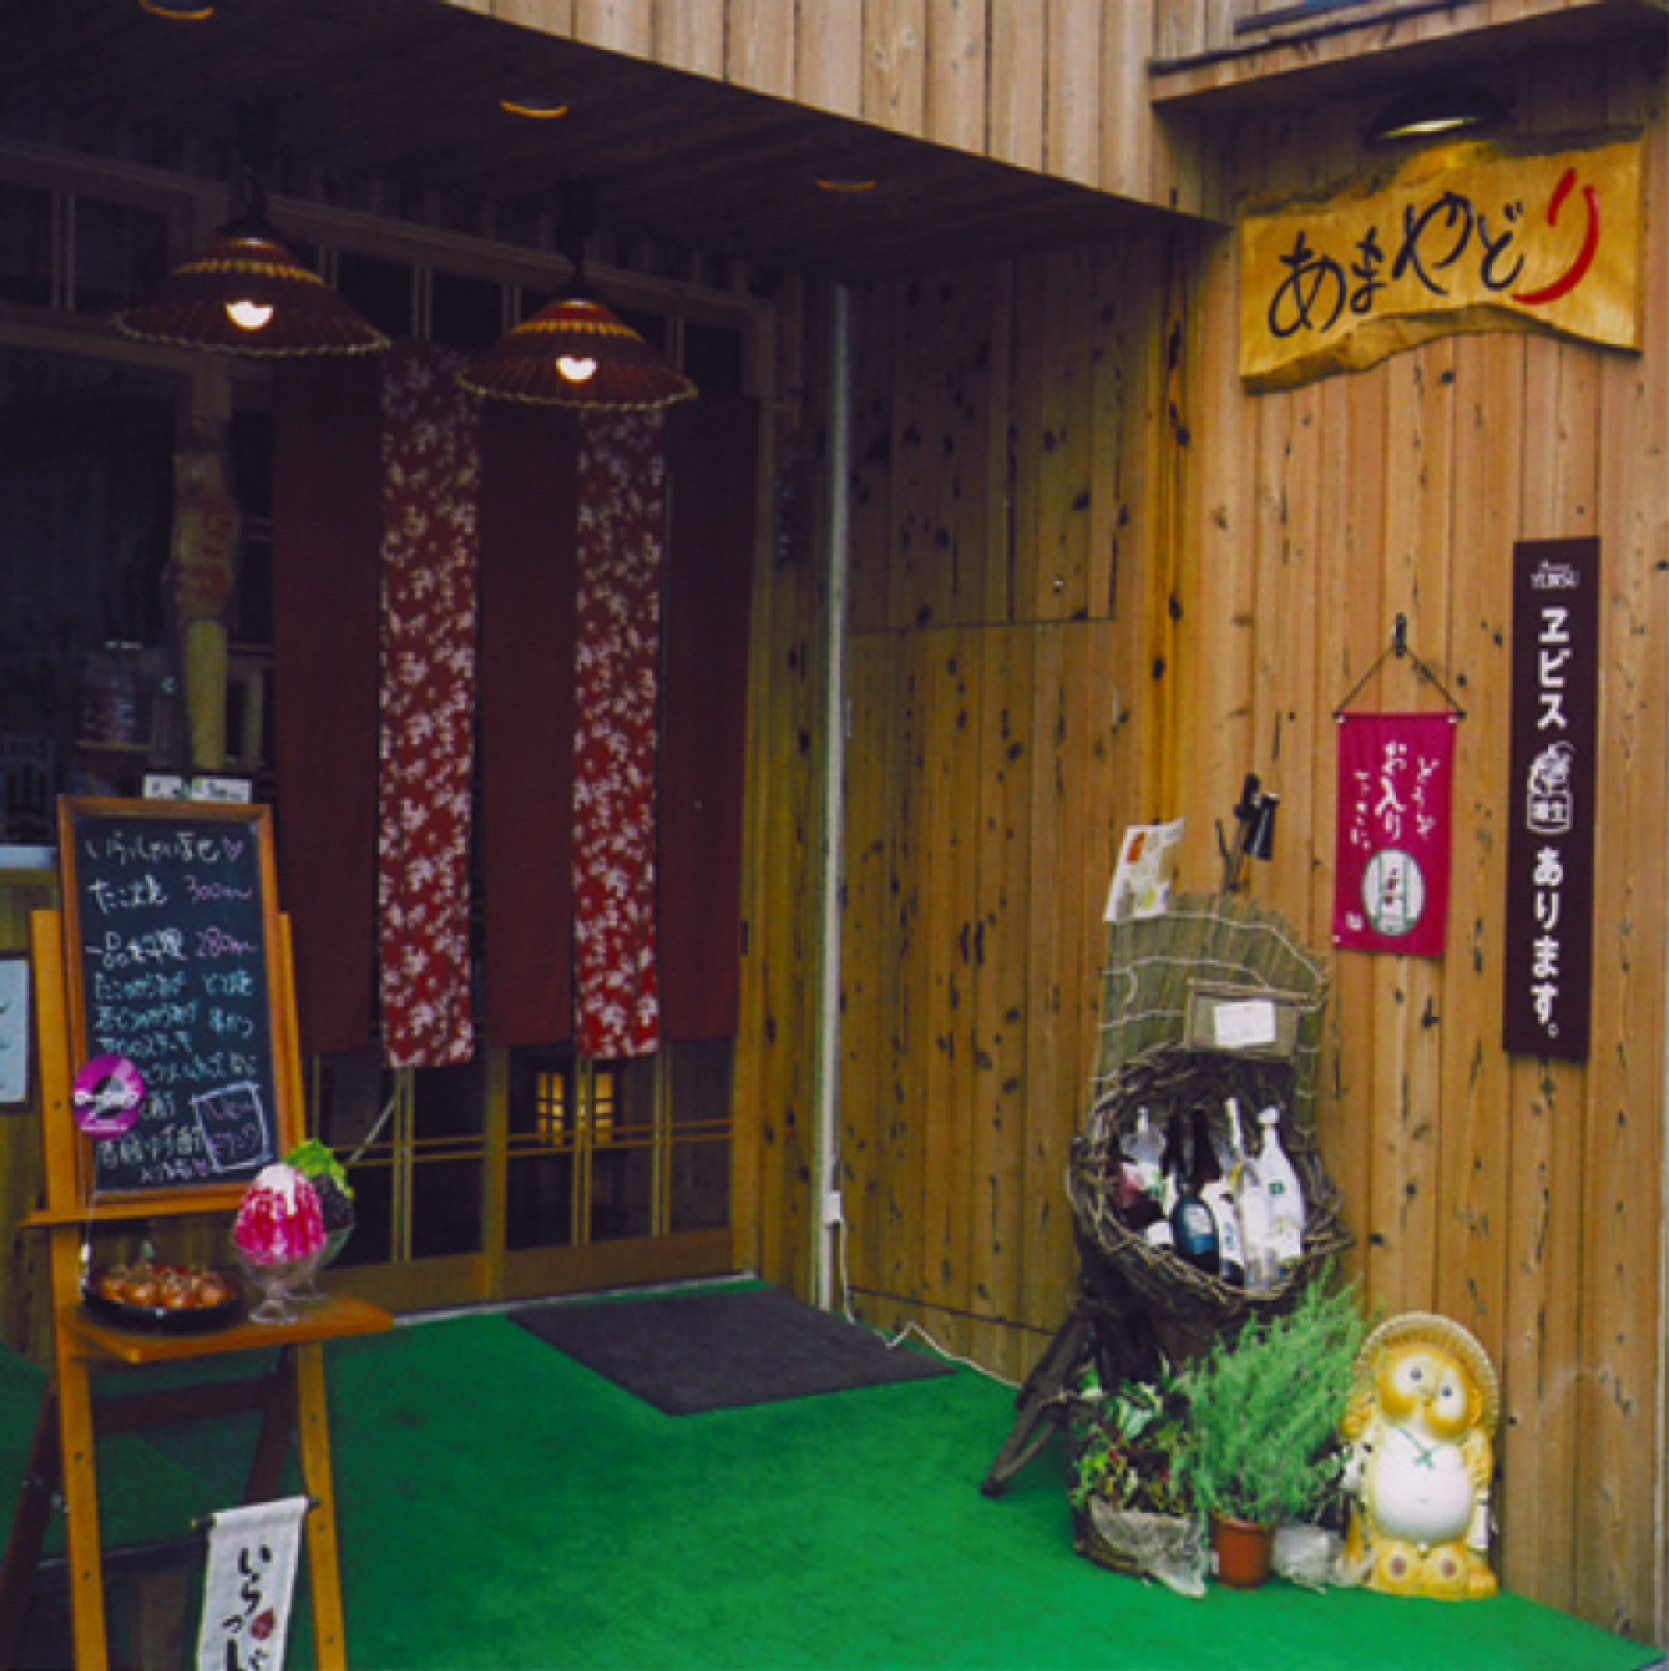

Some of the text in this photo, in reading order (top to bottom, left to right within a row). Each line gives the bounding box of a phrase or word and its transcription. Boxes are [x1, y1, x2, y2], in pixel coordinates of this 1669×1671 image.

[1268, 167, 1600, 338] あまやどり
[1374, 740, 1408, 841] お入り
[1530, 846, 1564, 1039] あります。
